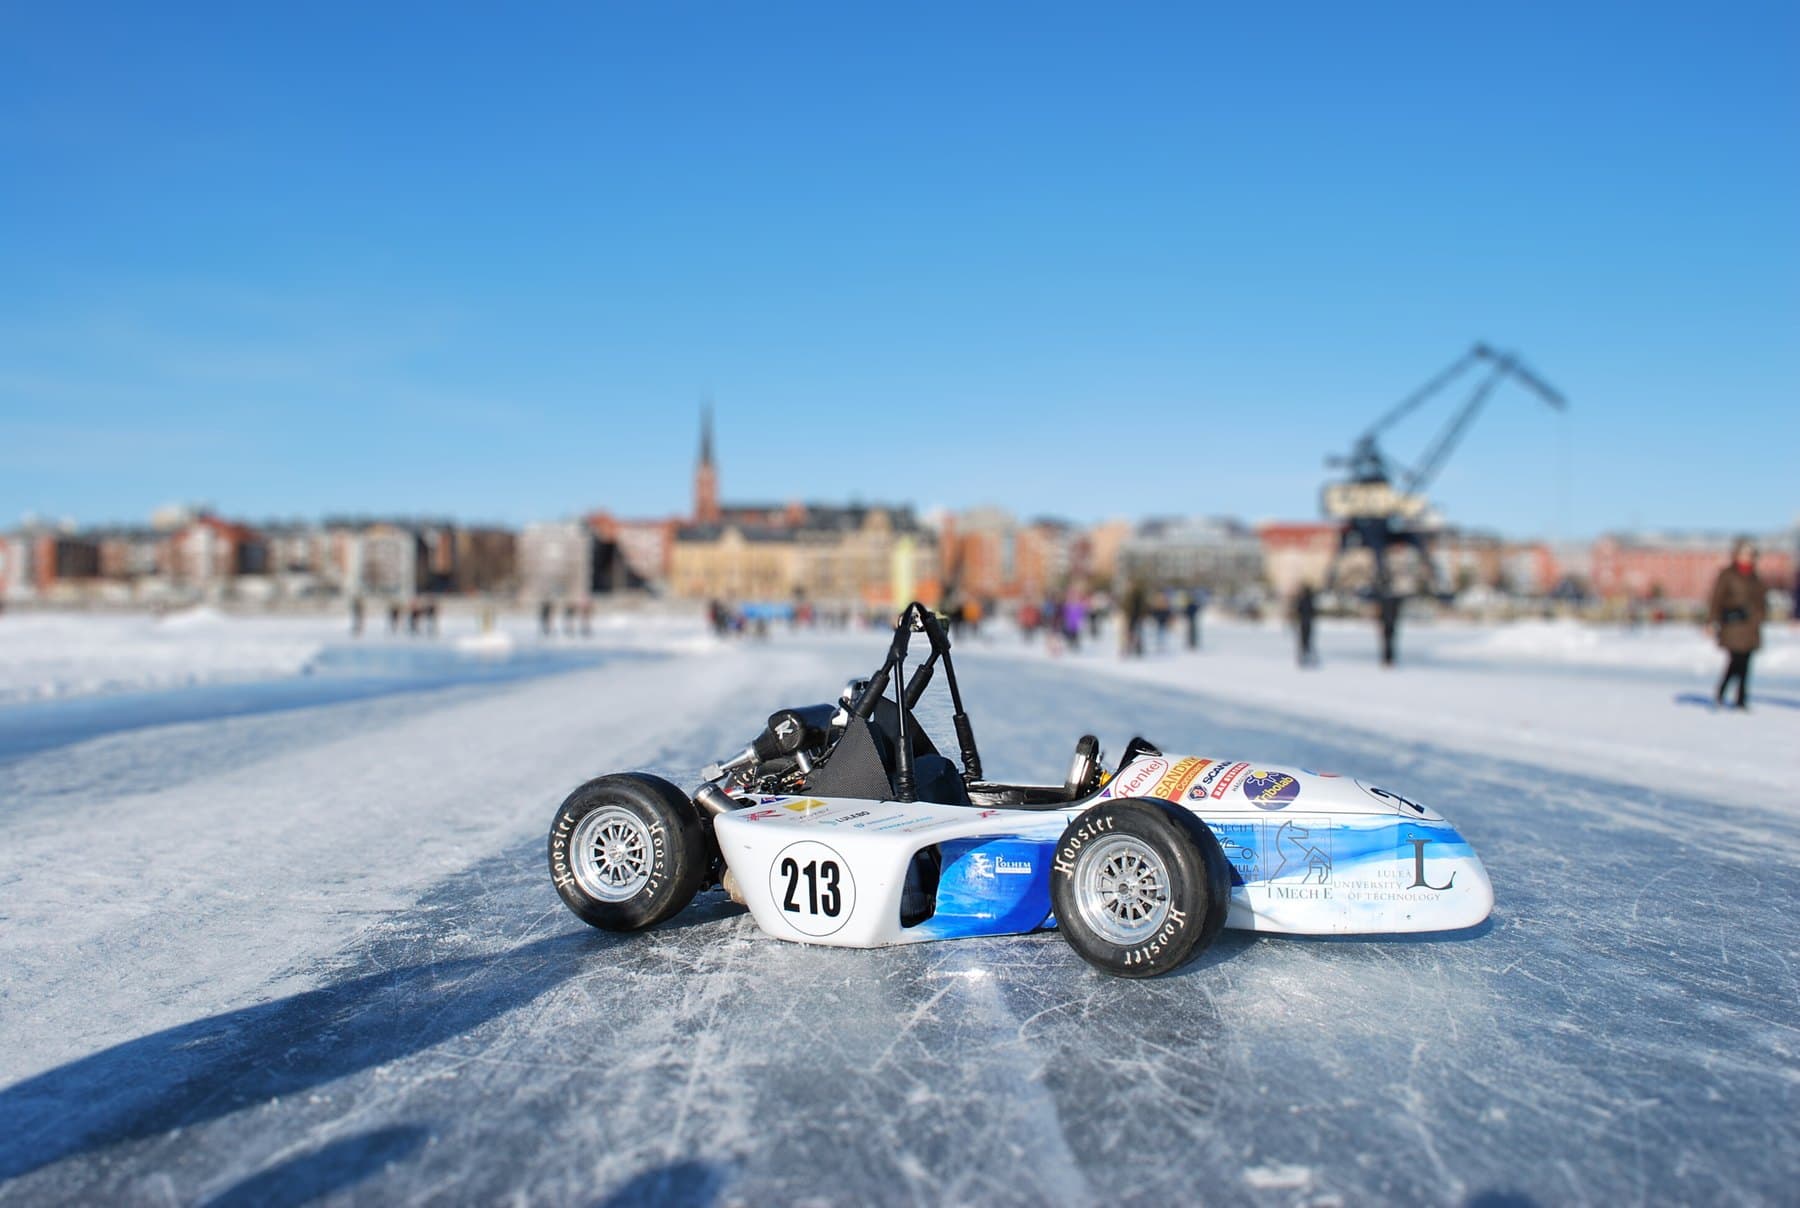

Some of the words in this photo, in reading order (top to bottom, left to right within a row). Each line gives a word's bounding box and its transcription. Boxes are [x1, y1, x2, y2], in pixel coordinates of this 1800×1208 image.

[1119, 759, 1163, 798] Henkel
[552, 812, 575, 888] Hoosier
[645, 820, 668, 898] Hoosier
[1054, 815, 1114, 880] Hoosier
[781, 857, 842, 918] 213
[1278, 887, 1319, 900] MECH
[1323, 887, 1334, 900] E
[1334, 880, 1404, 890] UNIVERSITY
[1347, 891, 1363, 901] OF
[1366, 892, 1441, 903] TECHNOLOGY
[1124, 901, 1186, 966] Hoosier
